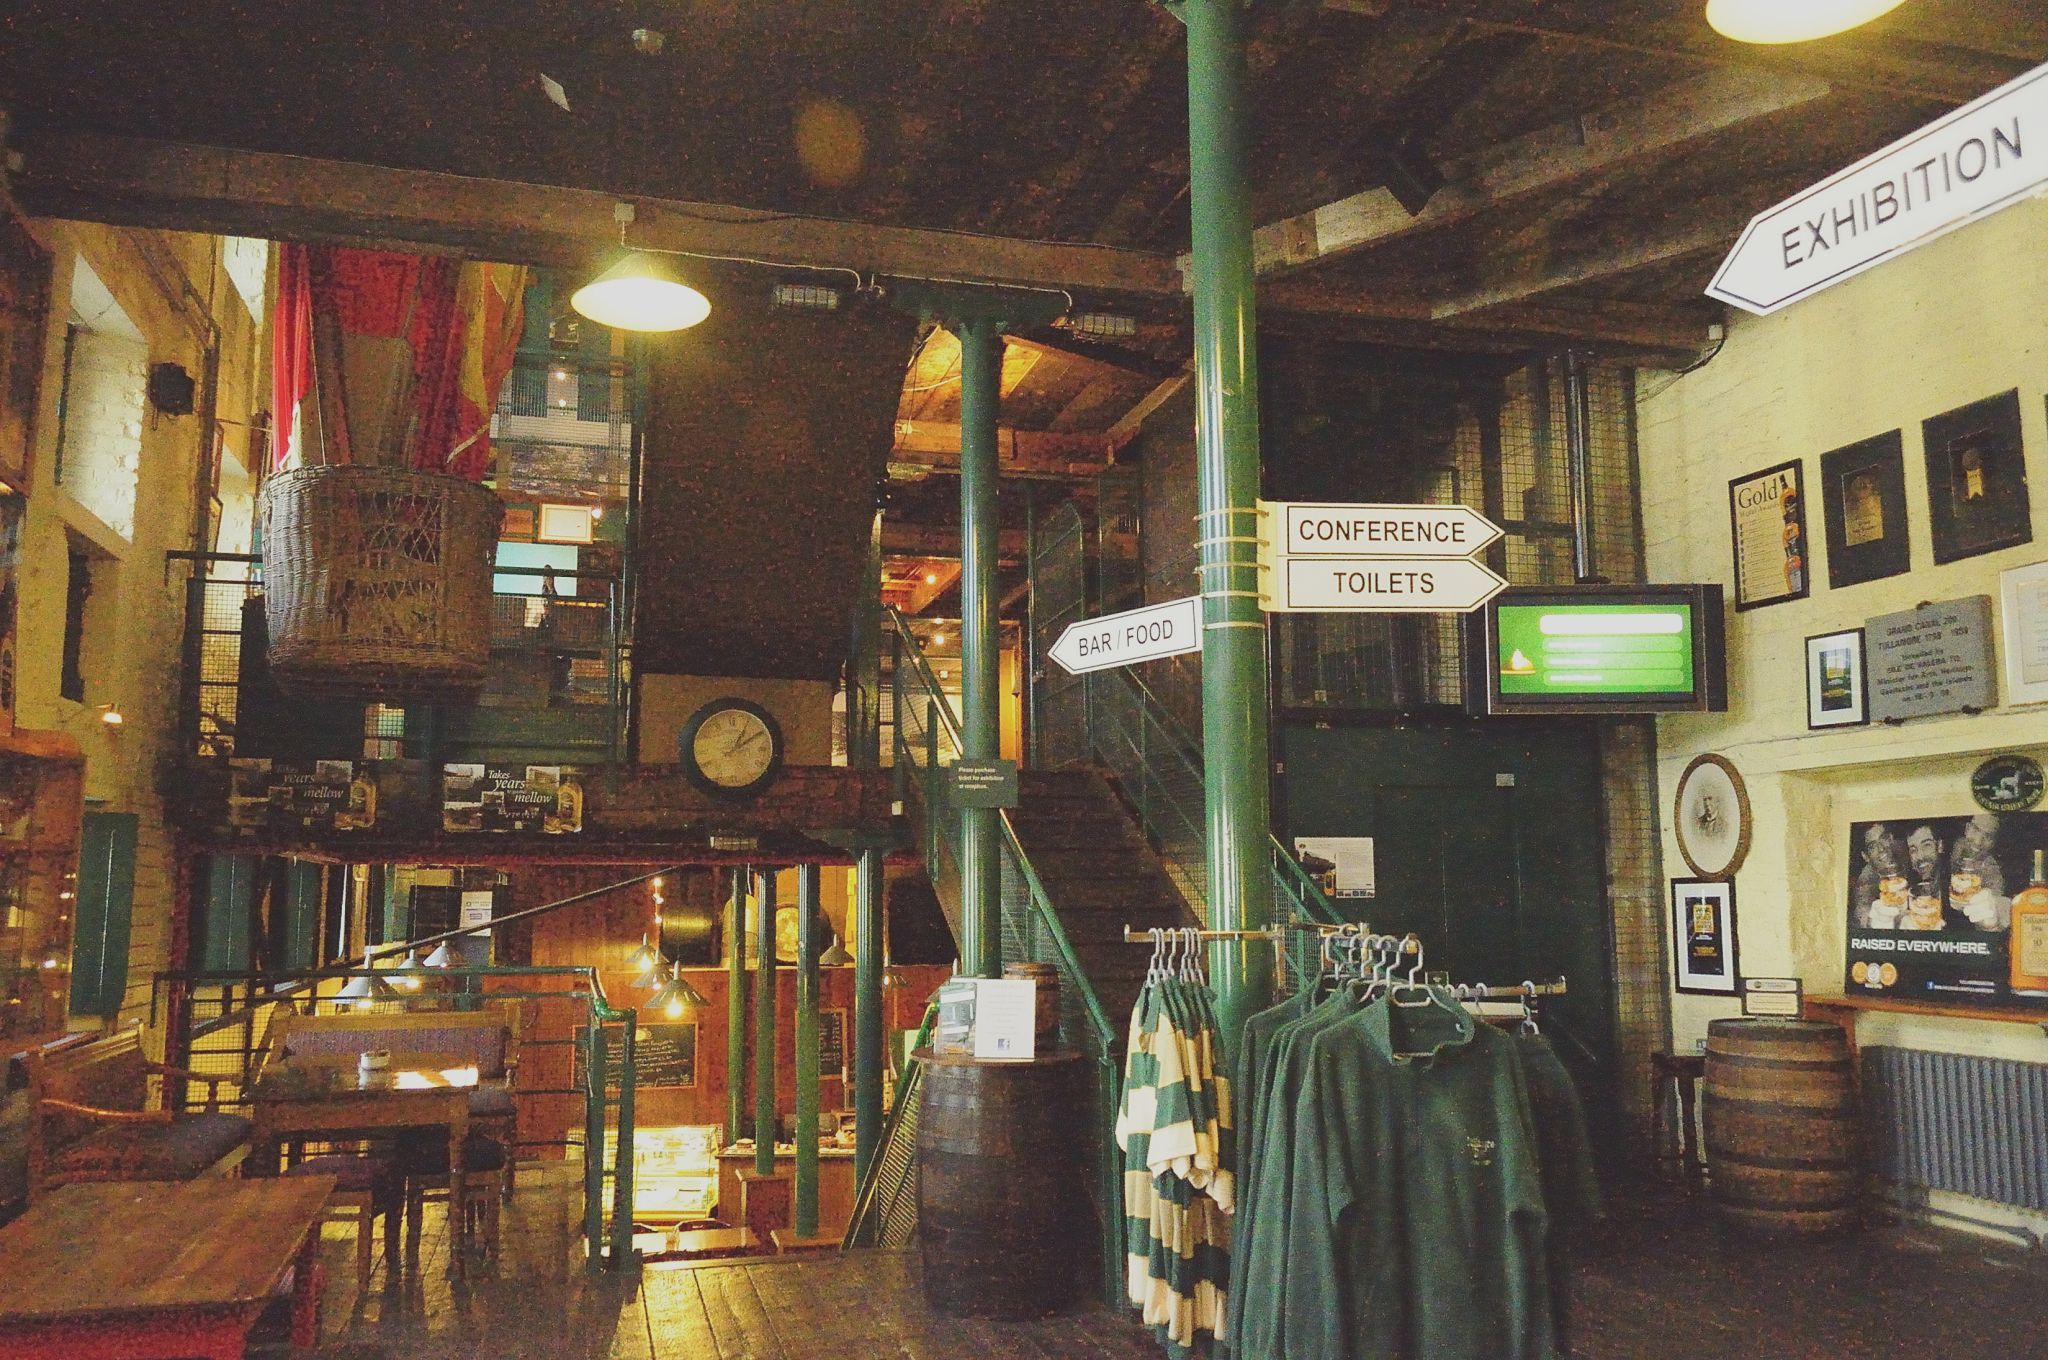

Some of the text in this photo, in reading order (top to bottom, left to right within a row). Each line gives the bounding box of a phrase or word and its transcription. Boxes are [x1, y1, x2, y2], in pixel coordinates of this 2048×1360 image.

[1781, 116, 2023, 269] EXHIBITION
[1738, 478, 1778, 509] Gold
[1300, 519, 1466, 542] CONFERENCE
[1333, 572, 1434, 594] TOILETS
[1079, 632, 1112, 657] BAR
[1126, 619, 1173, 647] FOOD
[1878, 635, 1921, 651] TULLAMORE
[281, 773, 316, 787] years
[488, 769, 511, 779] Takes
[303, 785, 344, 798] mellow
[492, 779, 526, 792] years
[514, 791, 553, 803] mellow
[1851, 938, 1991, 955] RAISED EVERYWHERE.
